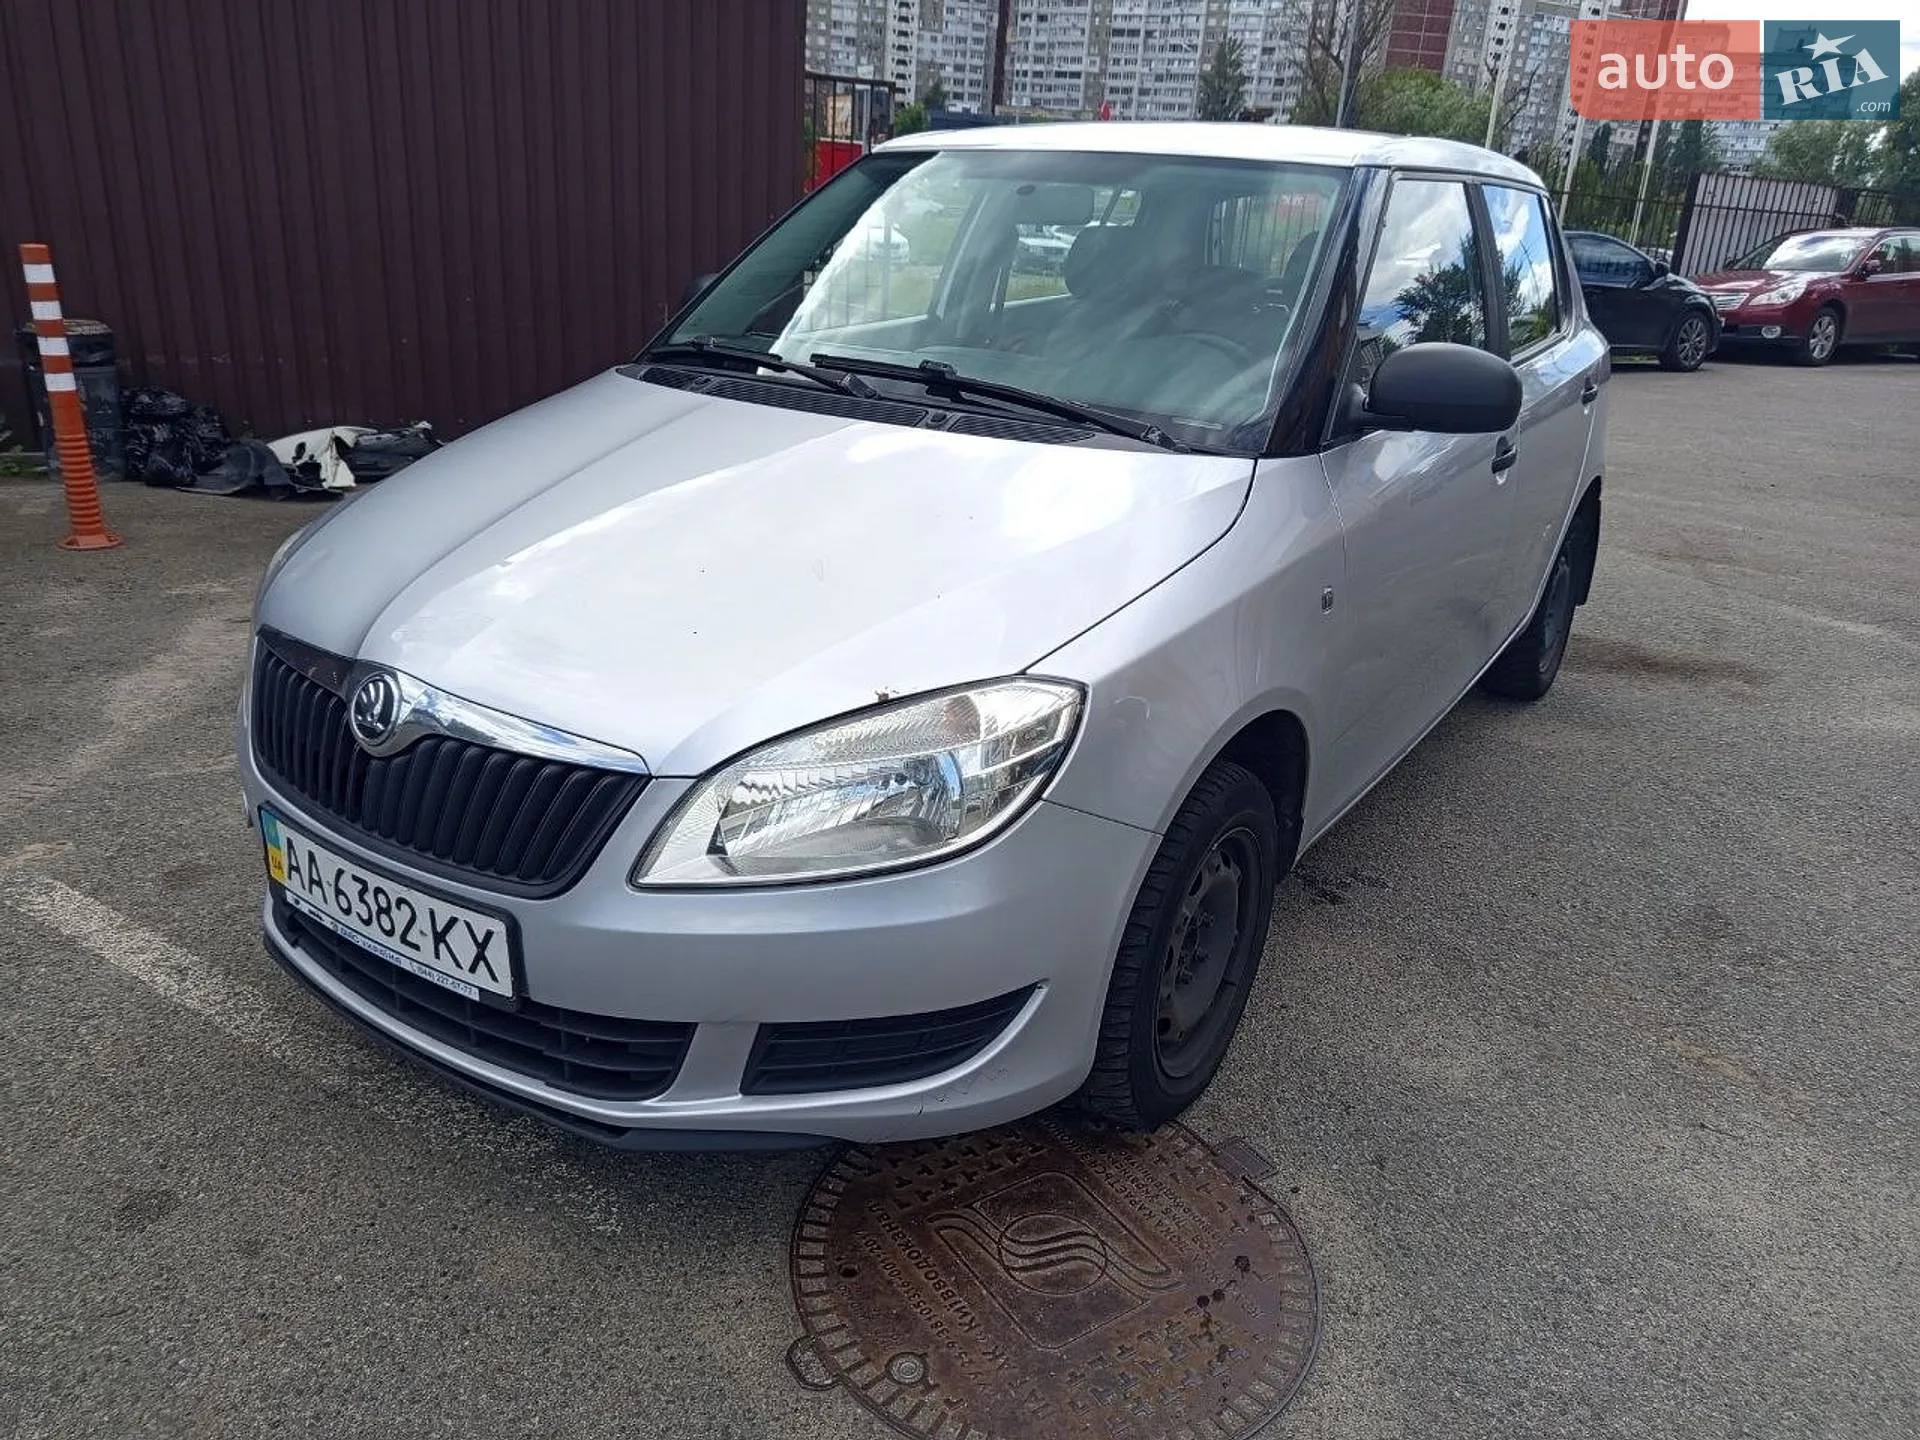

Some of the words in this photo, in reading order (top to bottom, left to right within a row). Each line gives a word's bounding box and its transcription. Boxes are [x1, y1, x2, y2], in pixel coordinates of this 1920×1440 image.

[287, 837, 328, 904] AA
[334, 868, 420, 951] 6382
[429, 908, 499, 982] KX
